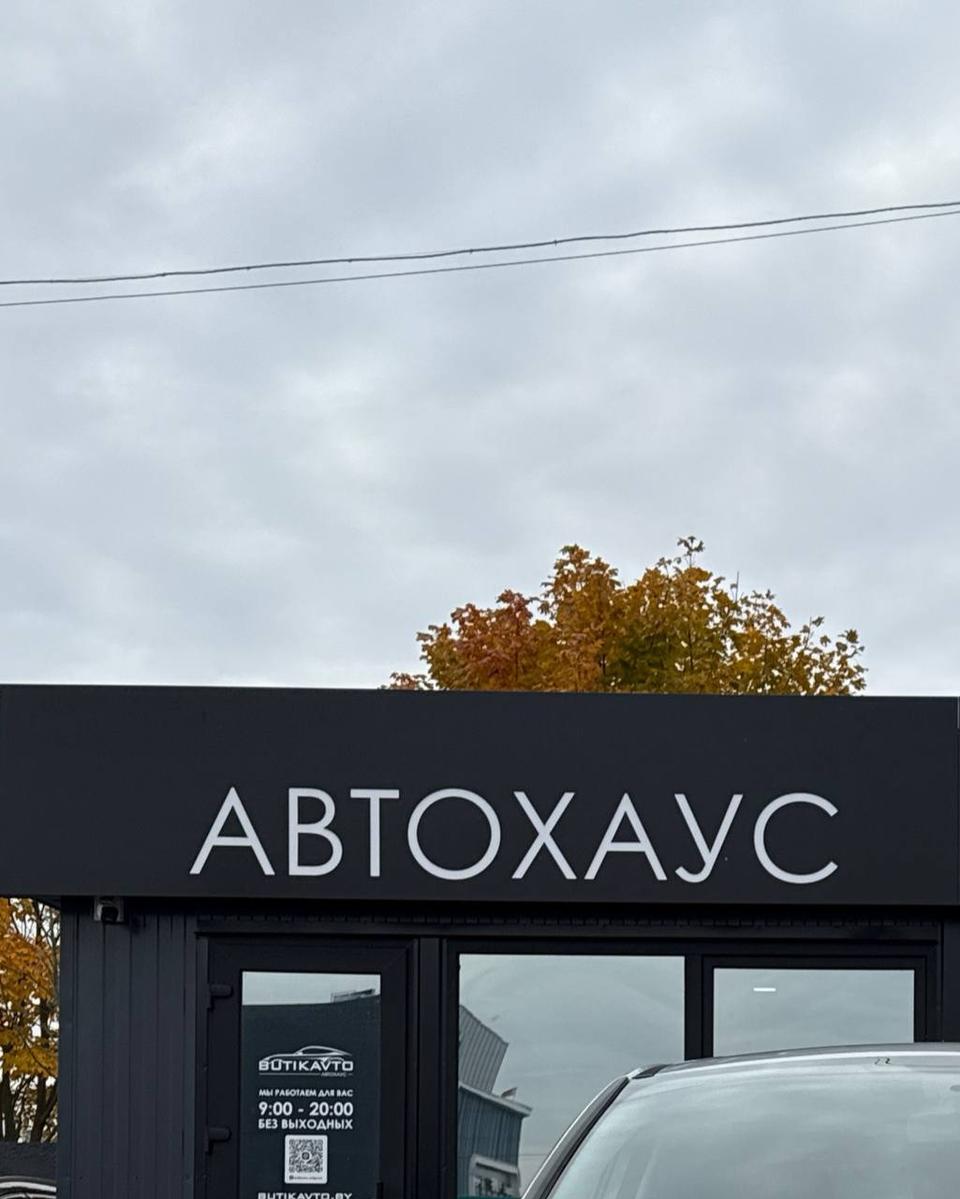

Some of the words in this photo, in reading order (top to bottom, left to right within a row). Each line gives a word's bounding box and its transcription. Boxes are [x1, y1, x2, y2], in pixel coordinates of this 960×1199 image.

[189, 786, 839, 885] АВТОХАУС
[258, 1060, 354, 1071] BUTIKAVTO
[259, 1089, 273, 1097] МЫ
[275, 1089, 317, 1097] РАБОТАЕМ
[318, 1089, 335, 1097] ДЛЯ
[336, 1089, 353, 1097] ВАС
[259, 1101, 293, 1116] 9:00
[309, 1102, 353, 1116] 20:00
[258, 1118, 278, 1129] БЕЗ
[281, 1118, 353, 1130] ВЫХОДНЫХ
